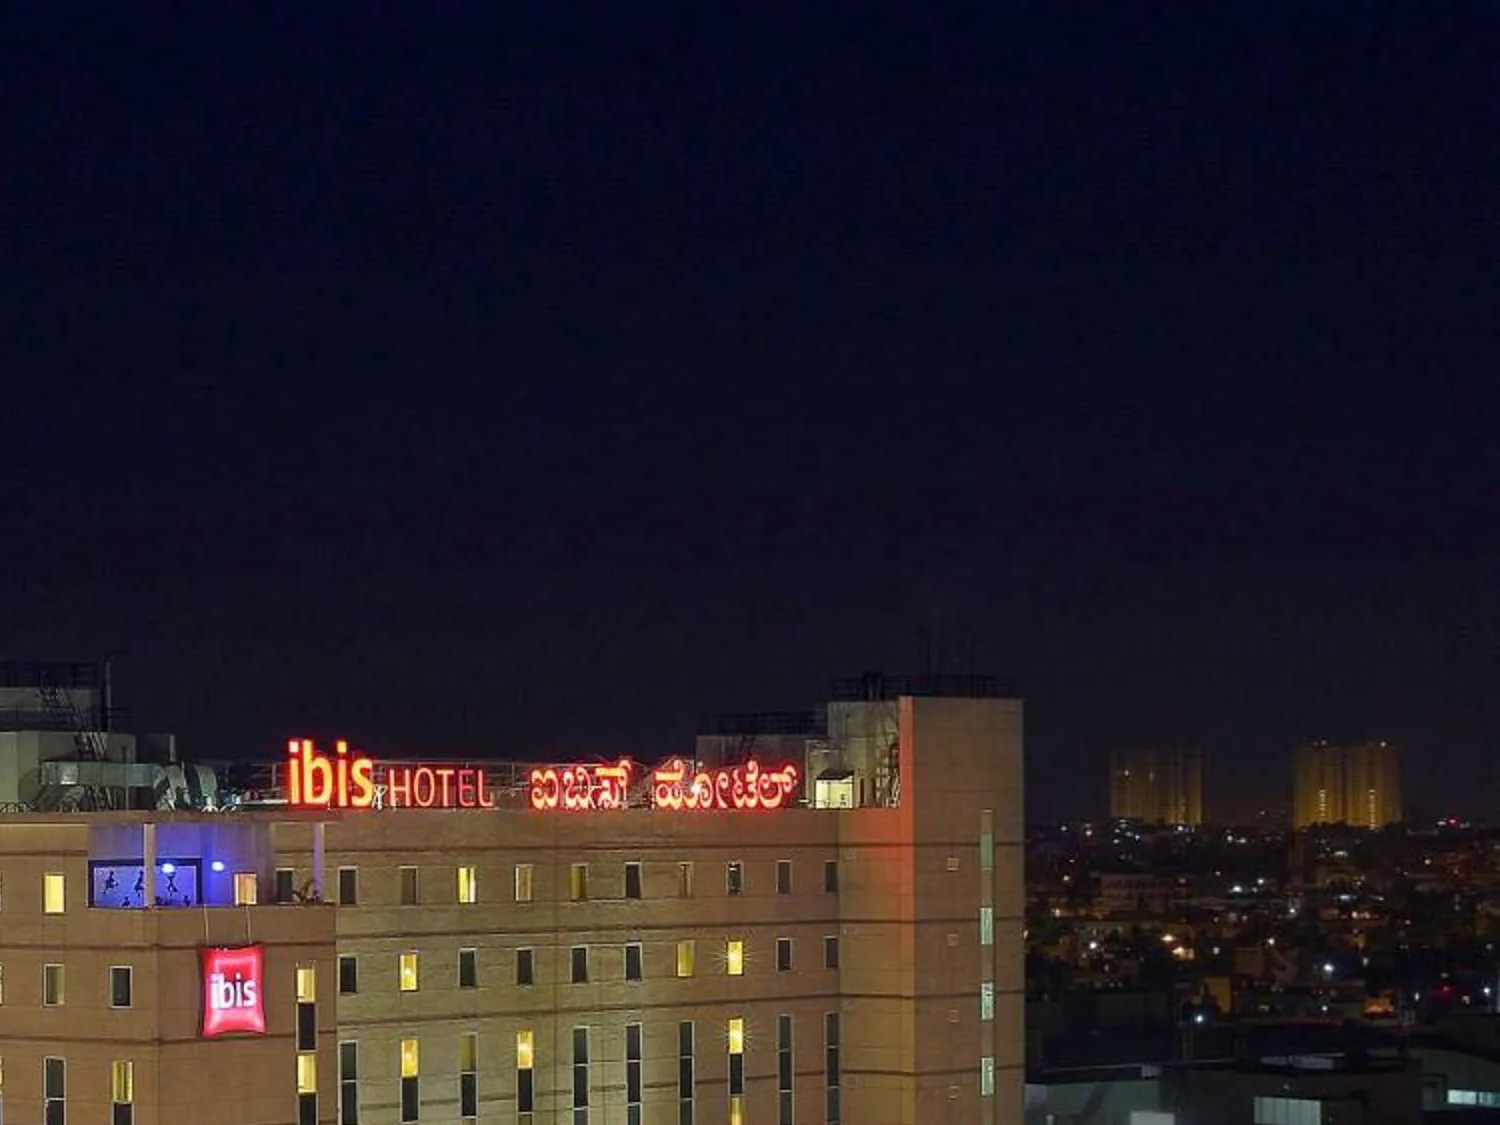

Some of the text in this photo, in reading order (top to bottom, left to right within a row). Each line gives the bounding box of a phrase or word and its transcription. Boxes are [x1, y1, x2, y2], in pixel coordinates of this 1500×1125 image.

[289, 740, 494, 807] ibis HOTEL
[531, 759, 631, 809] ಐಬಿಸ್
[211, 972, 257, 1009] ibis
